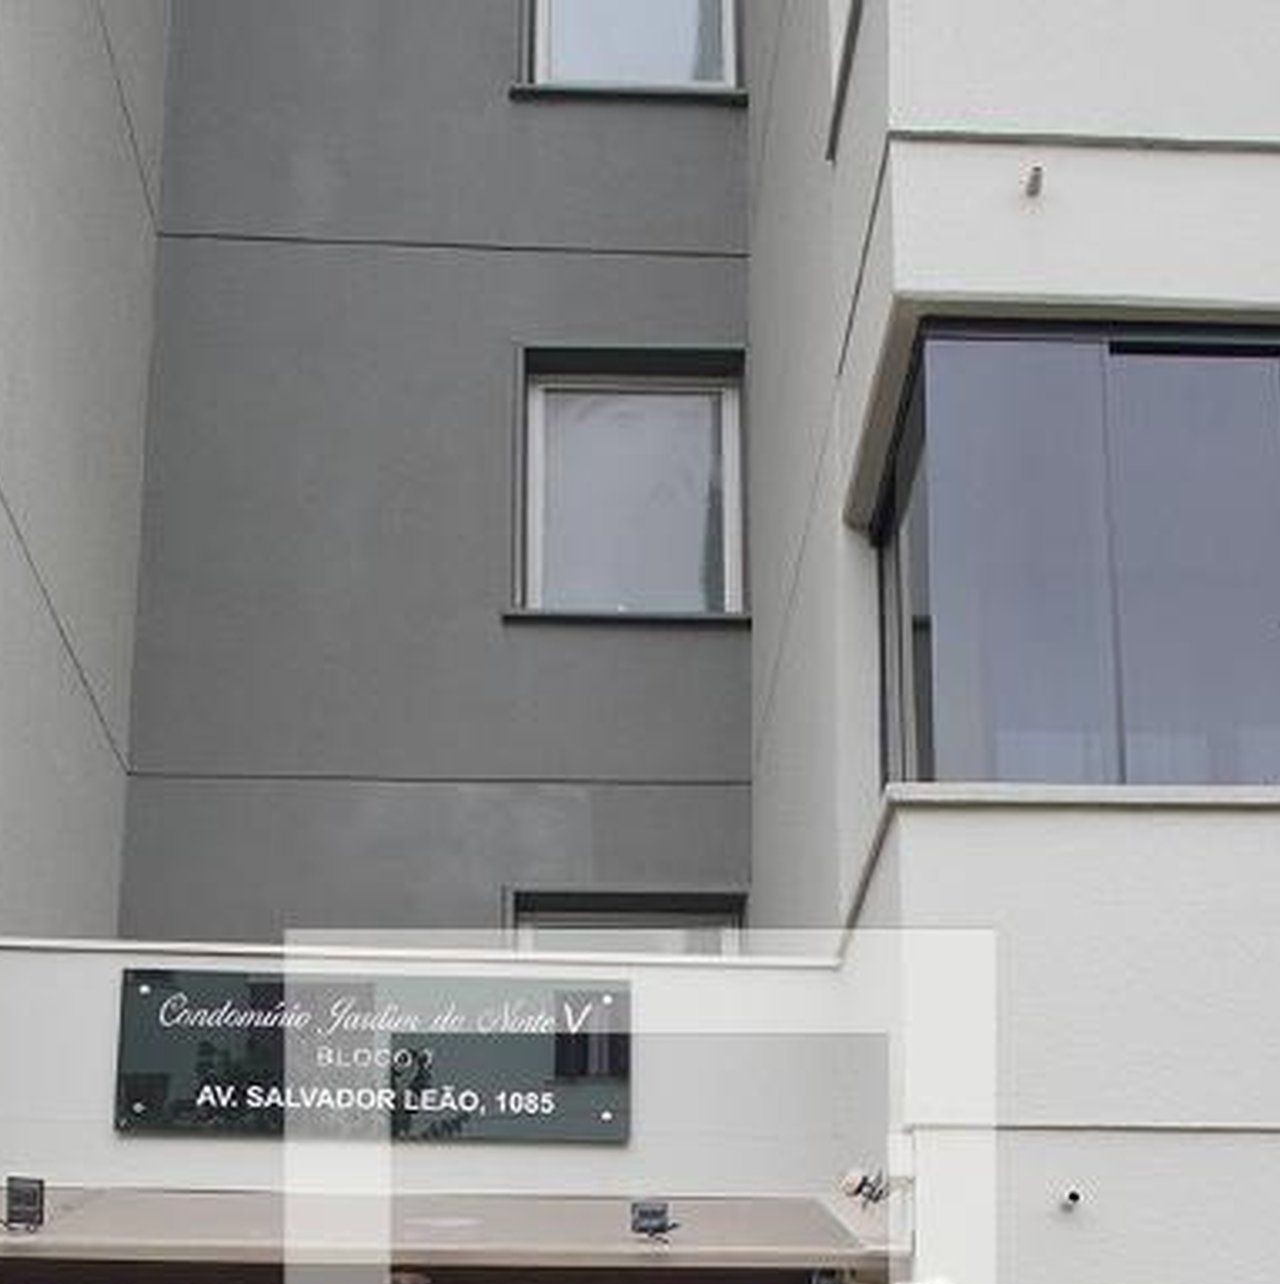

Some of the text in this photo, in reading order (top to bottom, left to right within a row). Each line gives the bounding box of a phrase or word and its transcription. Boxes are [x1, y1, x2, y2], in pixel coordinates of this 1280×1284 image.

[159, 992, 312, 1029] Condomínio
[475, 1001, 557, 1033] Norte
[563, 1001, 593, 1034] V
[316, 1046, 413, 1069] BLOCO
[195, 1084, 556, 1116] AV. SALVADOR LEÃO, 1085
